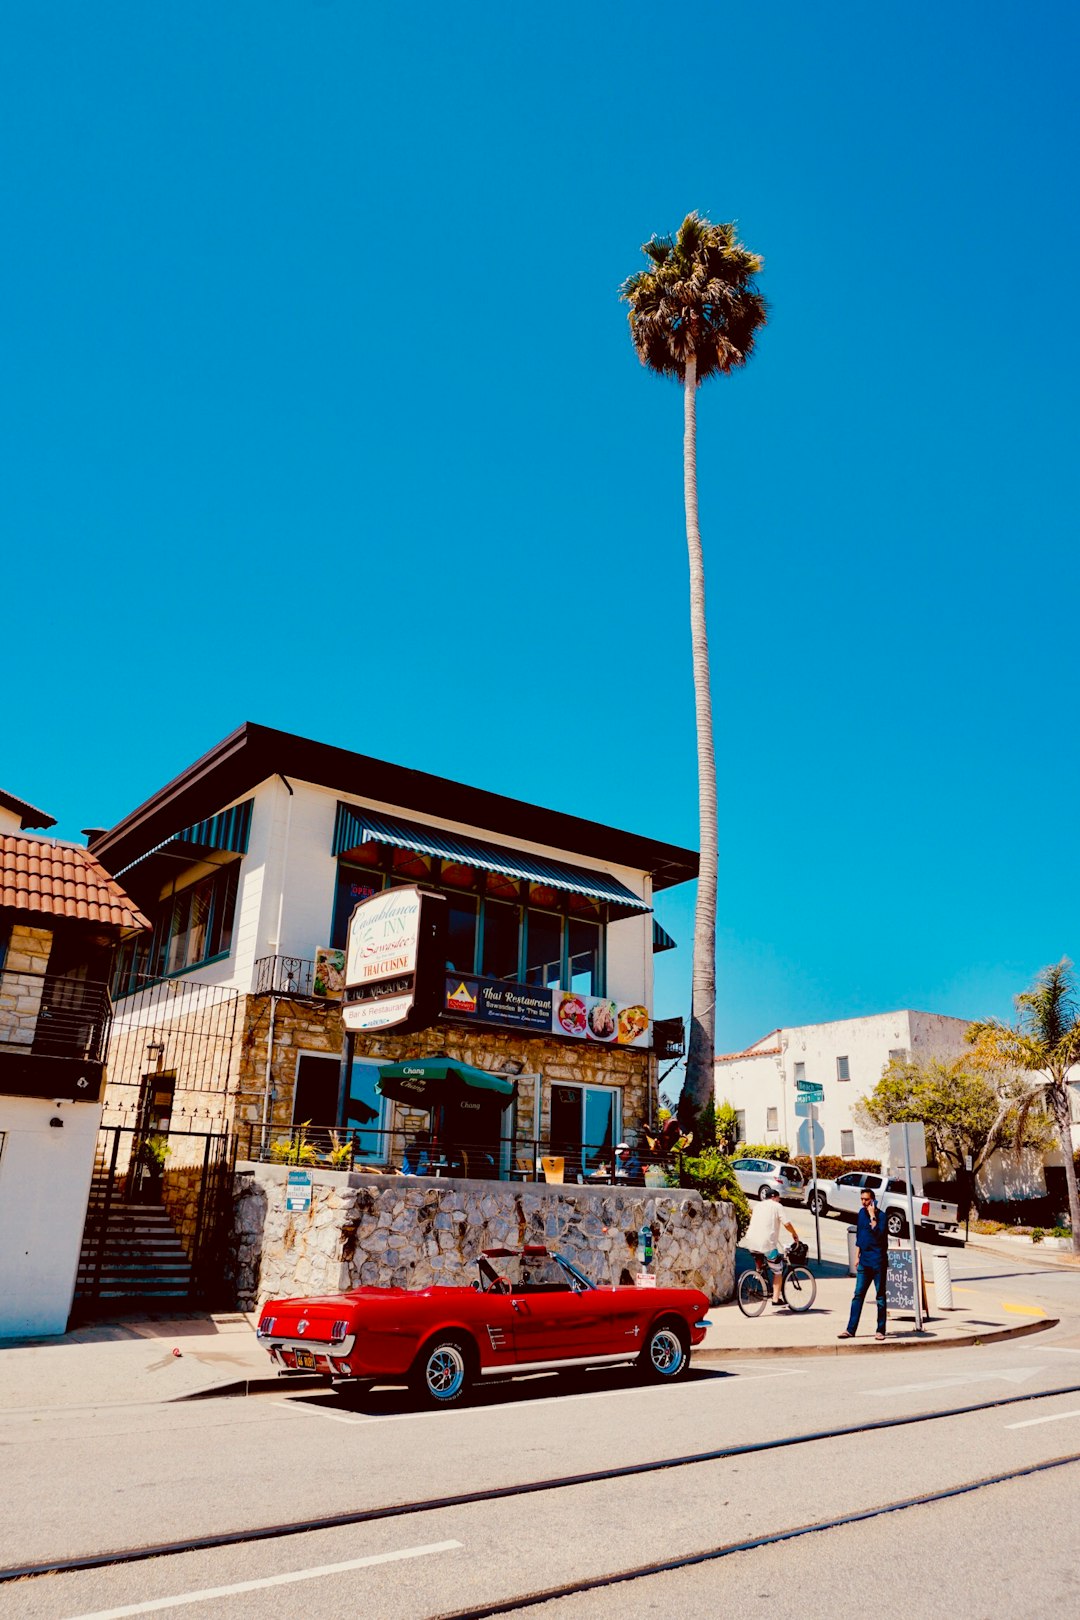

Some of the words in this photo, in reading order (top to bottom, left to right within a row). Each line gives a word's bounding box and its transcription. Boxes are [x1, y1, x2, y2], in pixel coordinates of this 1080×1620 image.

[352, 886, 373, 896] OPEN
[352, 893, 417, 935] Casablanca
[383, 915, 406, 938] INN
[364, 962, 379, 977] THAI
[380, 955, 409, 974] CUISINE
[370, 980, 409, 997] VACANCY
[483, 987, 502, 1001] Thai
[505, 992, 551, 1009] Restaurant
[349, 1010, 360, 1019] Bar
[369, 1002, 407, 1016] Restaurant
[403, 1066, 425, 1076] Chang
[400, 1080, 426, 1093] Chang
[797, 1094, 811, 1103] Main
[460, 1101, 481, 1111] Chang
[902, 1251, 913, 1263] Us
[892, 1259, 905, 1269] for
[885, 1290, 914, 1309] Cocktai
[298, 1356, 303, 1366] 66
